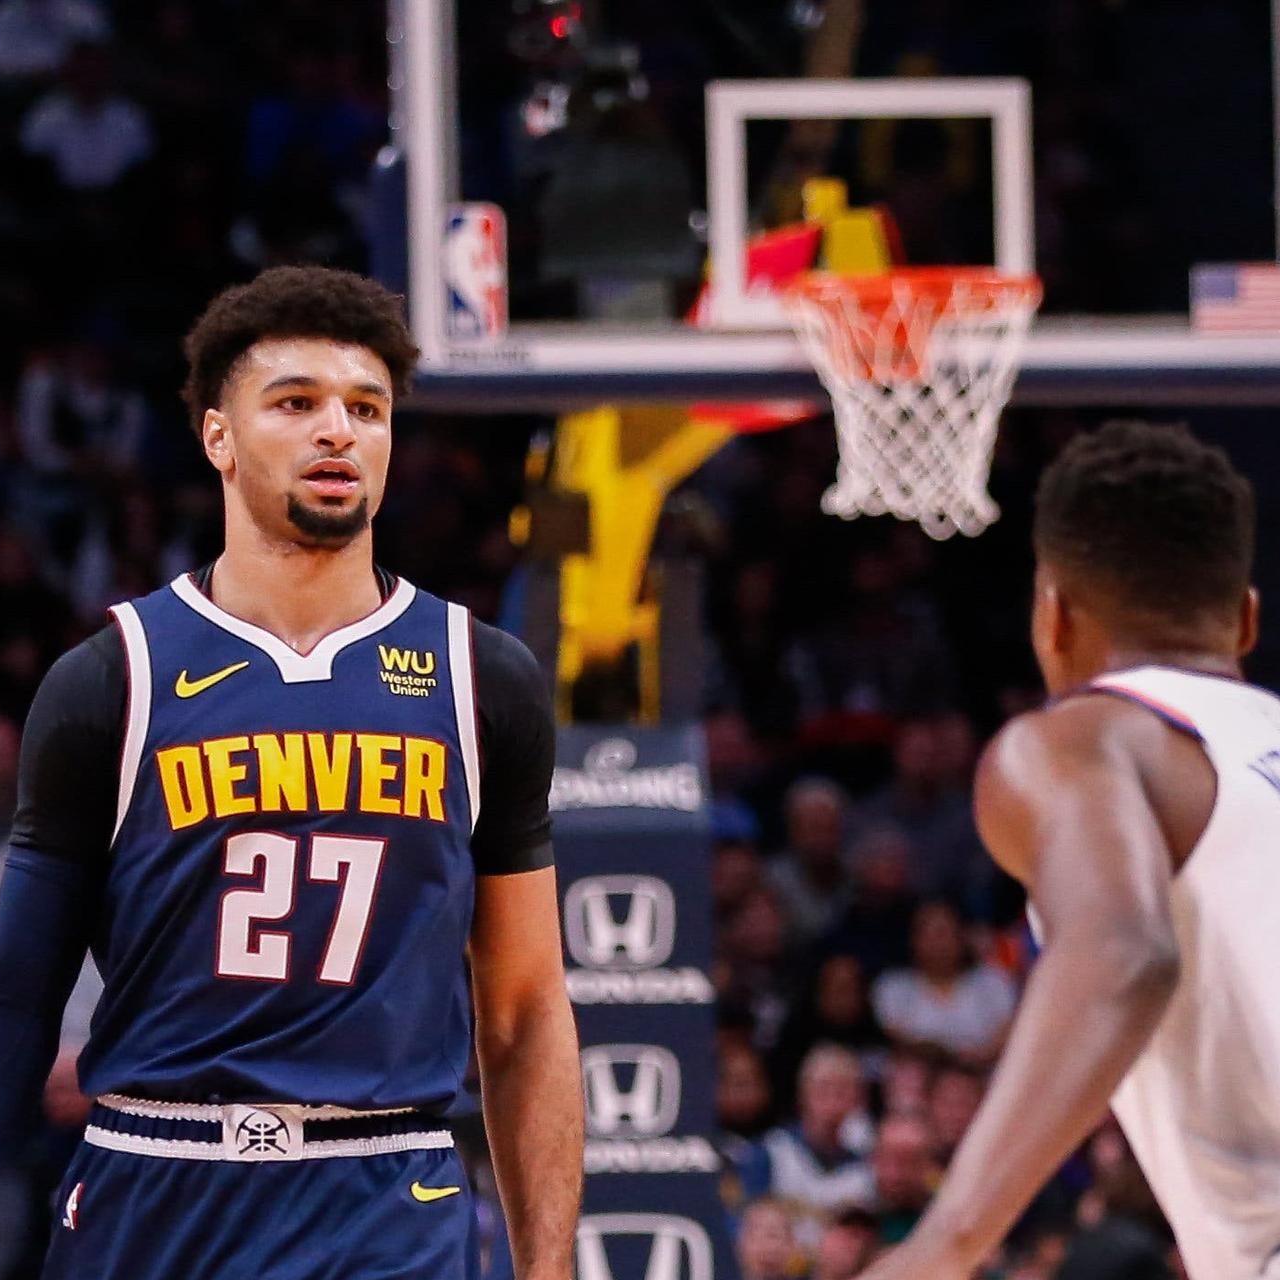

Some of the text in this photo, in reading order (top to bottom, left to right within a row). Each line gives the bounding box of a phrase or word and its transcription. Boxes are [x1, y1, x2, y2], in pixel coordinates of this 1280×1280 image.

[378, 644, 435, 675] WU
[379, 671, 437, 687] Western
[390, 684, 429, 697] Union
[156, 731, 448, 831] DENVER
[549, 765, 702, 812] PALDING
[215, 828, 389, 985] 27
[565, 967, 714, 1004] ONDA
[583, 1136, 720, 1174] ONDA
